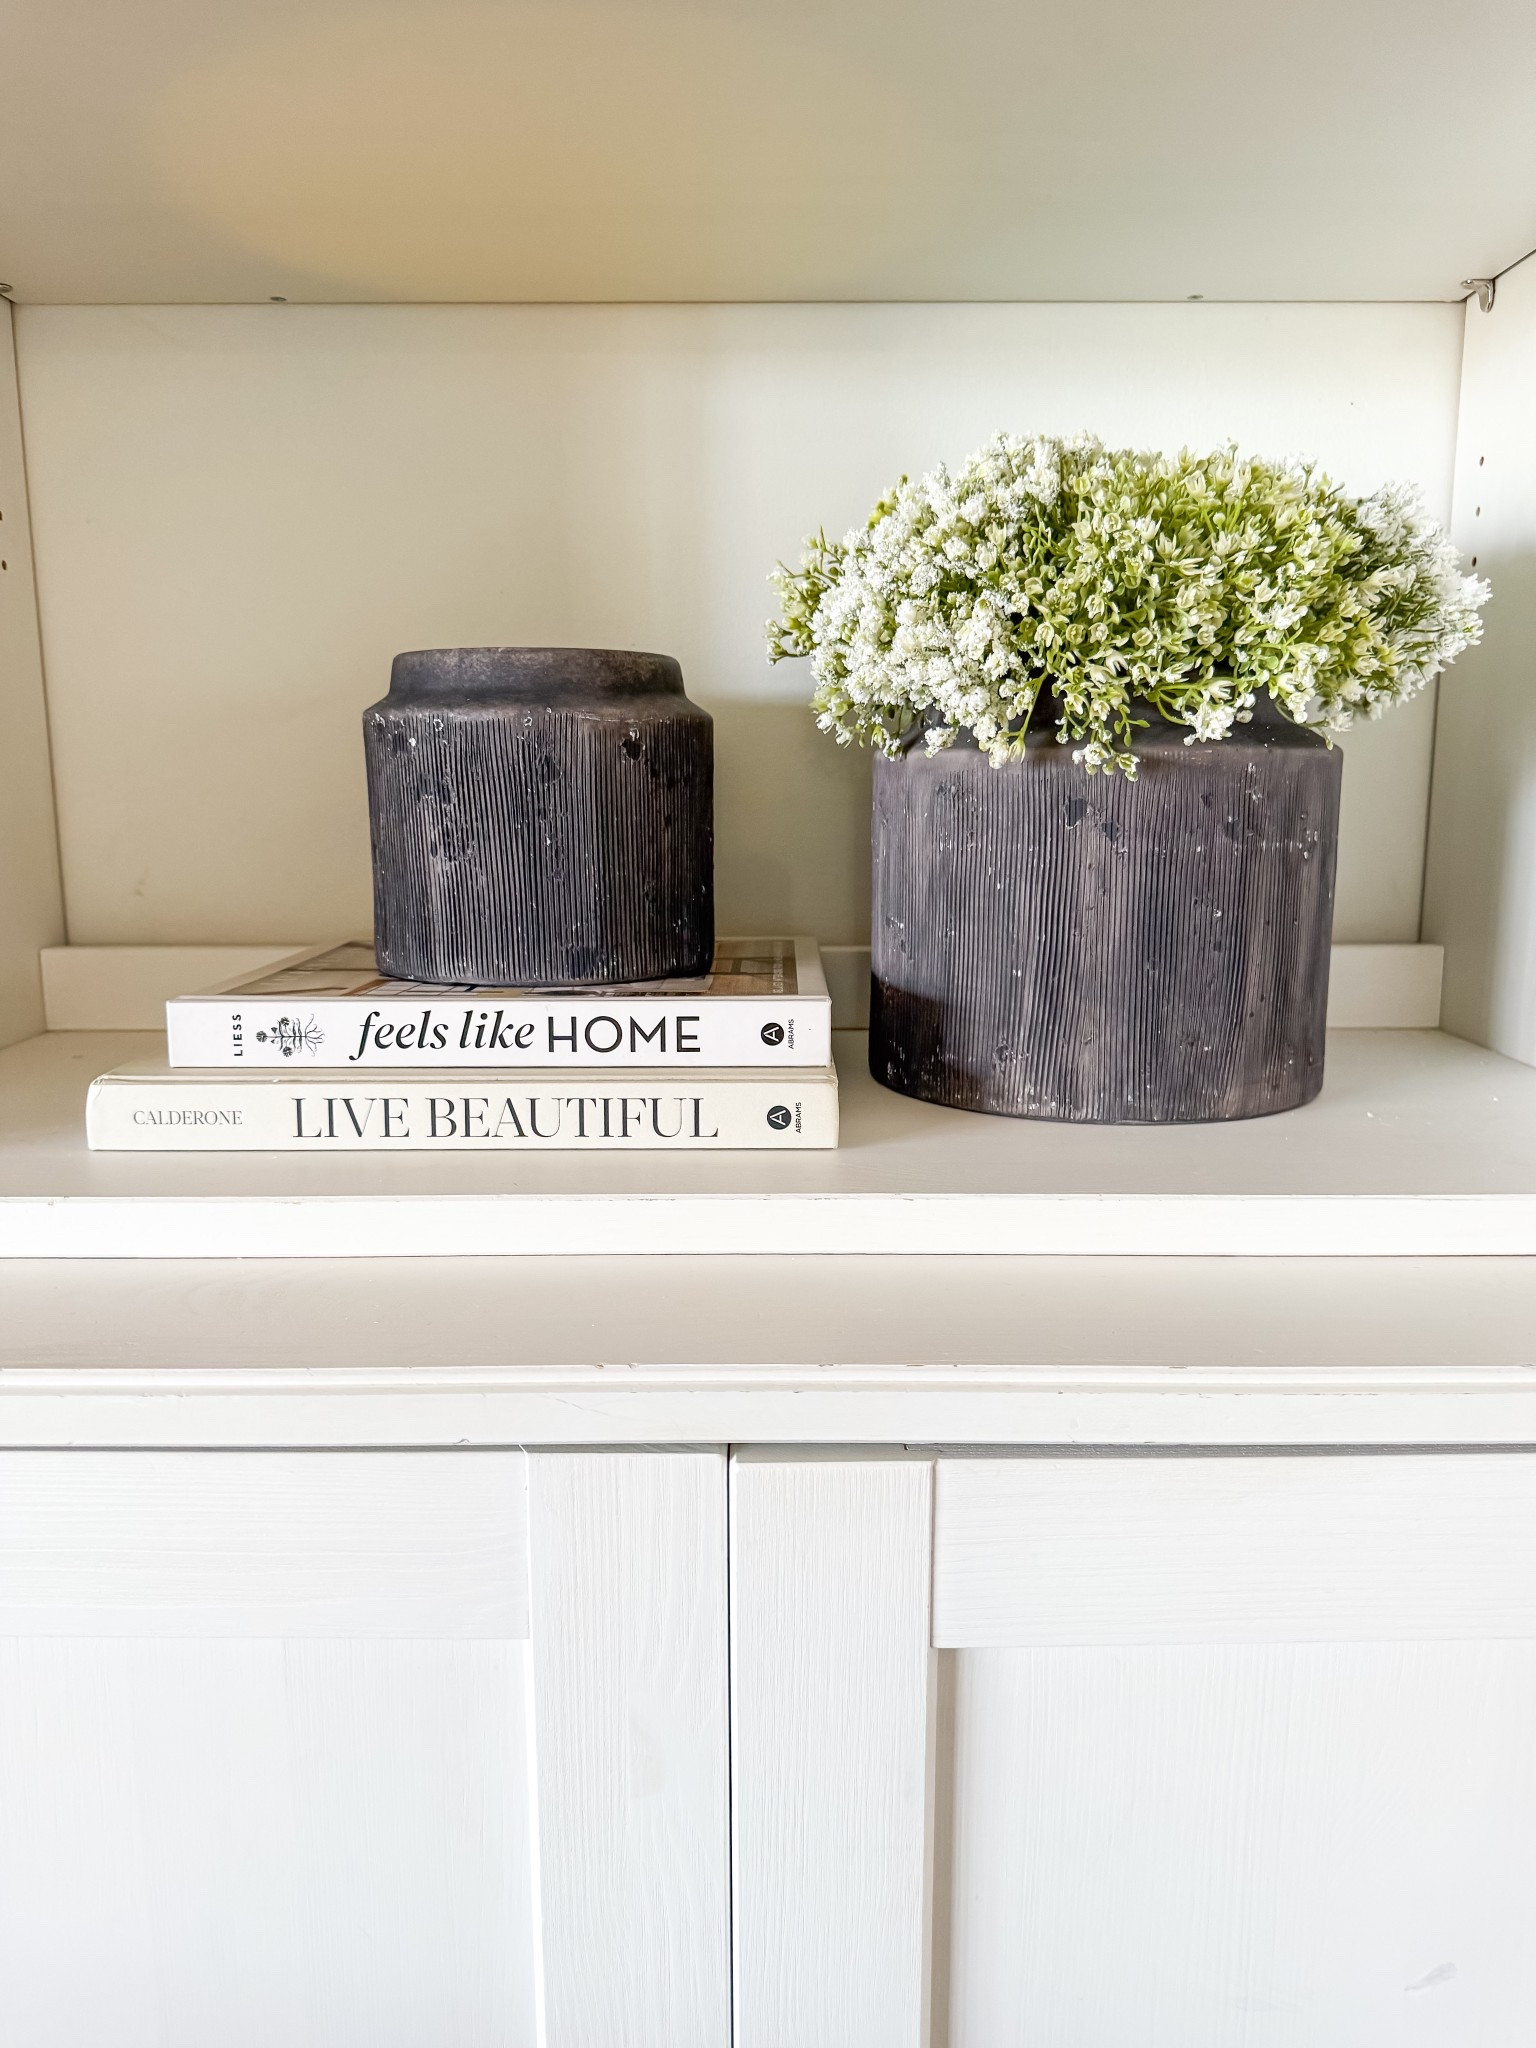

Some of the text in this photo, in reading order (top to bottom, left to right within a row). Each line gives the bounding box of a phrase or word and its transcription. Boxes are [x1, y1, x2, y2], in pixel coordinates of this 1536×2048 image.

[232, 1014, 243, 1056] LIESS
[348, 1009, 701, 1061] feels like HOME
[787, 1018, 795, 1050] ABRAMS
[133, 1110, 243, 1126] CALDERONE
[291, 1097, 719, 1138] LIVE BEAUTIFUL
